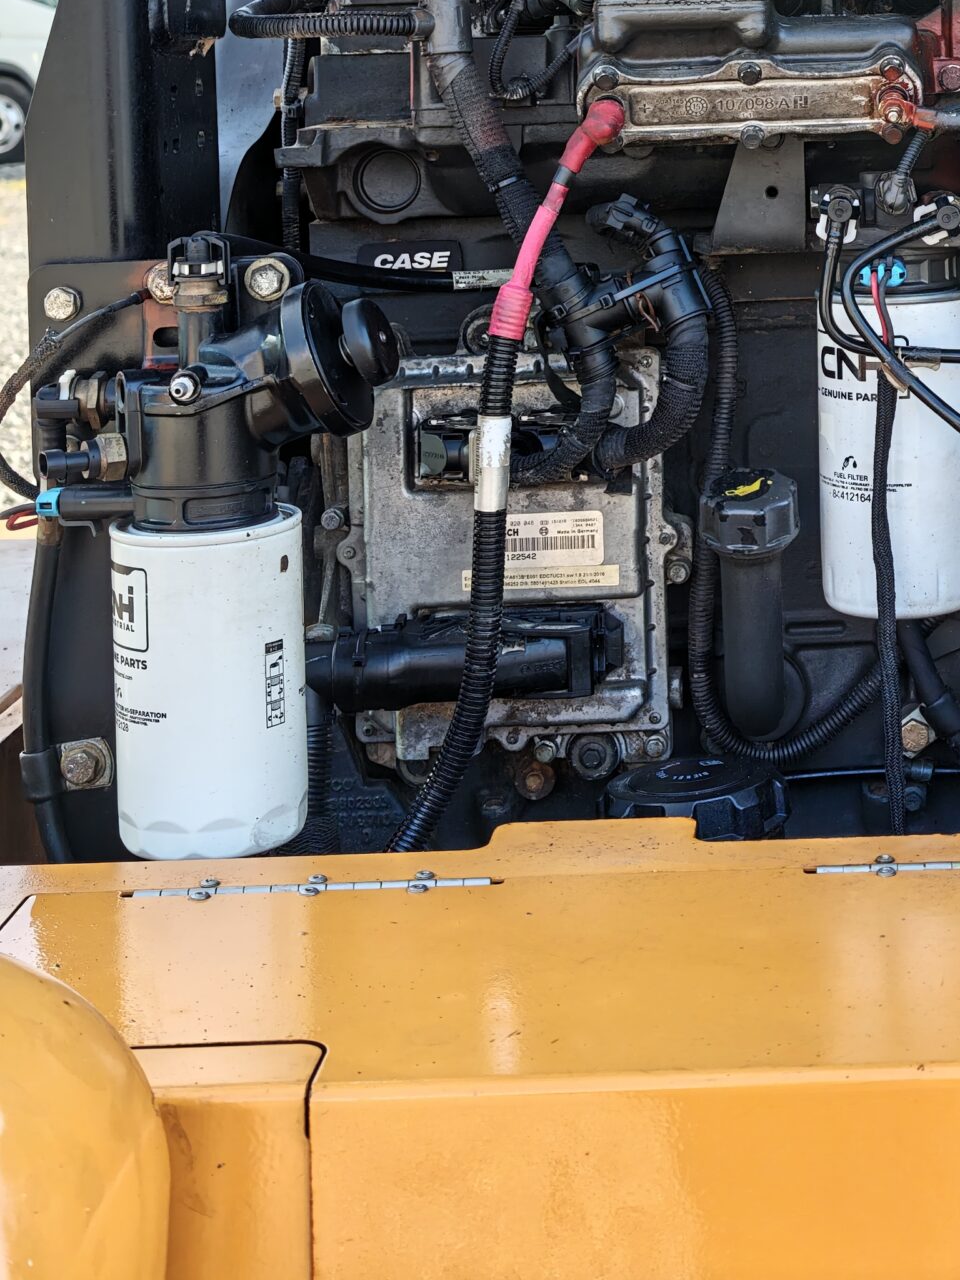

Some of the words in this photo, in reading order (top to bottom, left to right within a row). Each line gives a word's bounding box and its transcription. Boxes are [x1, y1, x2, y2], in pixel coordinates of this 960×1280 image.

[374, 251, 451, 270] CASE
[822, 387, 854, 401] GENUINE
[855, 392, 878, 402] PAR
[833, 471, 847, 480] FUEL
[847, 473, 869, 482] FILTER
[121, 655, 147, 670] PARTS
